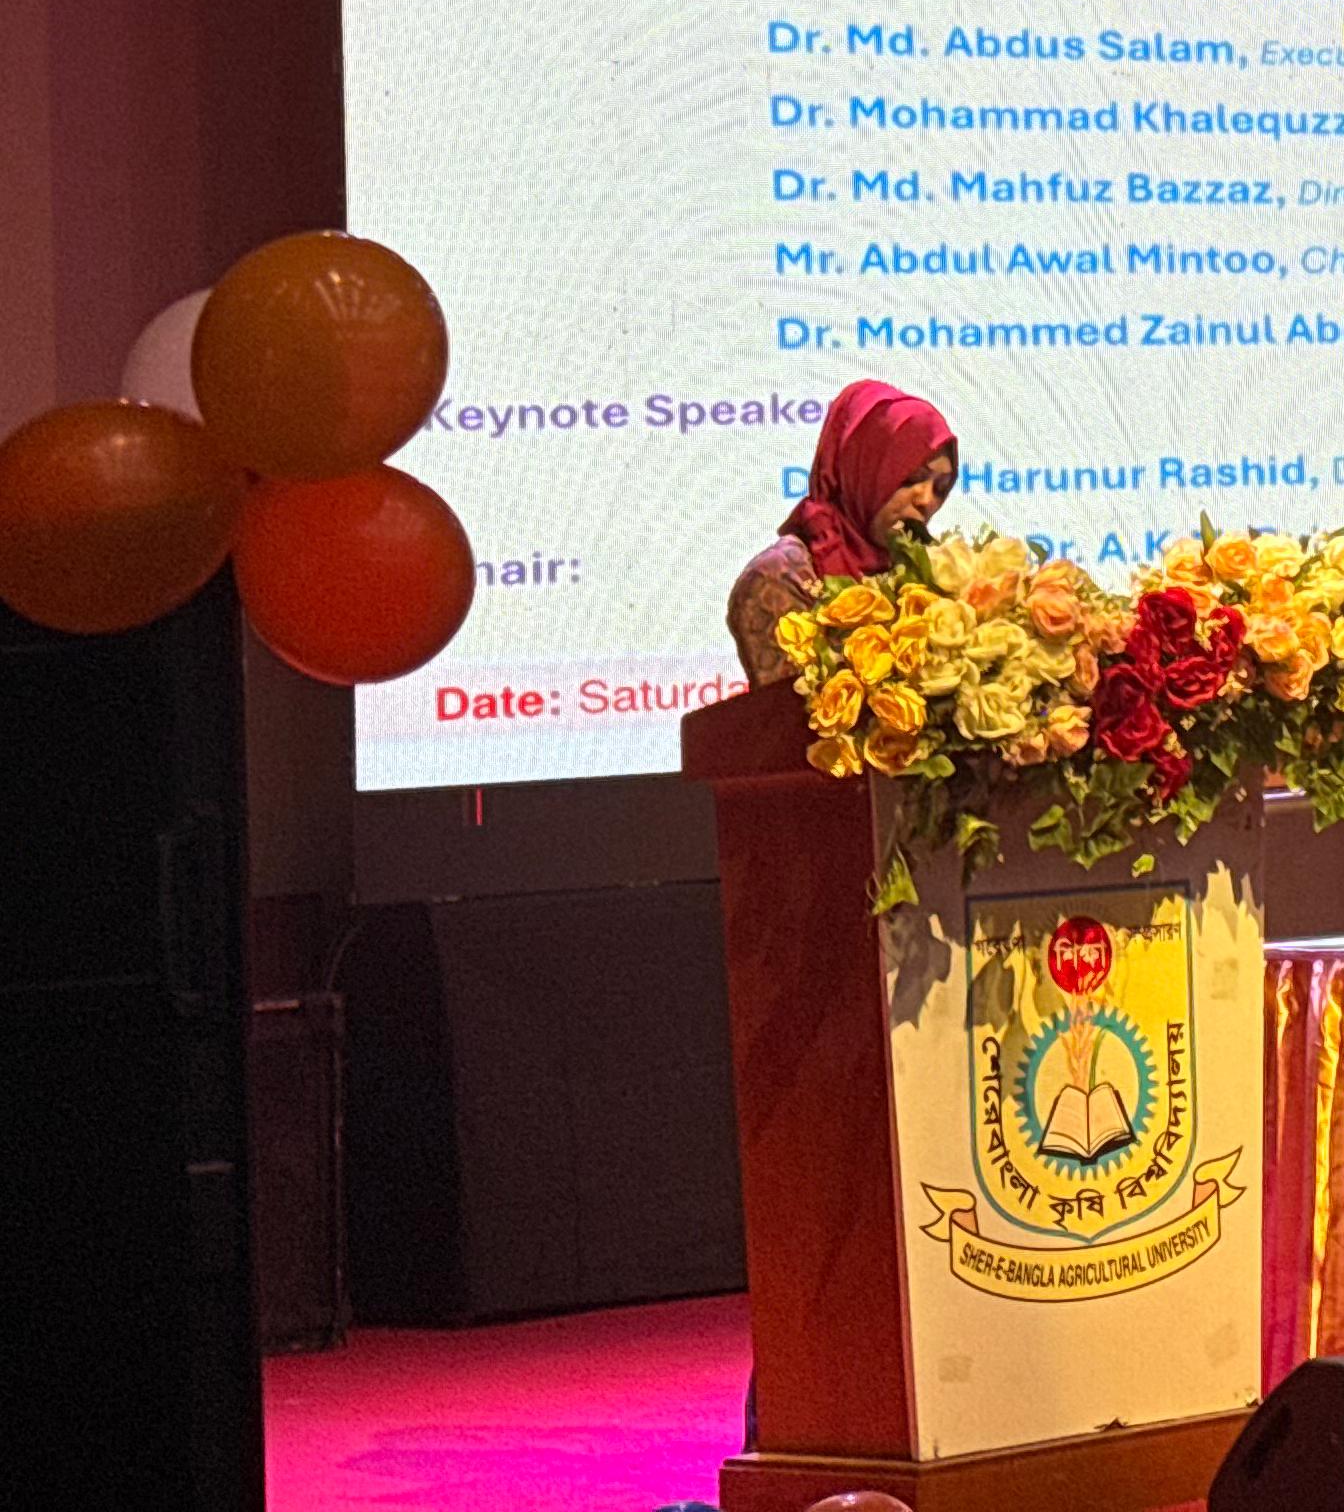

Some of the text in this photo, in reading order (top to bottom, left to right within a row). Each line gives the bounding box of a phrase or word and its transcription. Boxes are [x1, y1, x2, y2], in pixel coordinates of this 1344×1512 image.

[766, 19, 831, 55] Dr.
[846, 22, 929, 58] Md.
[943, 25, 1087, 62] Abdus
[1097, 28, 1249, 69] Salam,
[769, 94, 833, 128] Dr.
[848, 95, 1120, 133] Mohammad
[771, 167, 836, 202] Dr.
[850, 169, 934, 203] Md.
[950, 170, 1113, 204] Mahfuz
[1126, 172, 1287, 209] Bazzaz,
[773, 240, 845, 277] Mr.
[859, 242, 995, 276] Abdul
[1005, 242, 1114, 275] Awal
[1126, 243, 1288, 279] Mintoo,
[776, 315, 841, 351] Dr.
[855, 315, 1129, 349] Mohammed
[1140, 313, 1277, 347] Zainul
[644, 392, 830, 434] Speake
[961, 461, 1147, 494] Harunur
[1158, 454, 1320, 490] Rashid,
[436, 686, 561, 721] Date:
[1053, 936, 1109, 972] শিক্ষা
[1048, 1188, 1106, 1233] কৃষি
[960, 1216, 1211, 1288] SHER-E-BANGLA AGRICULTURAL UNIVERSITY
